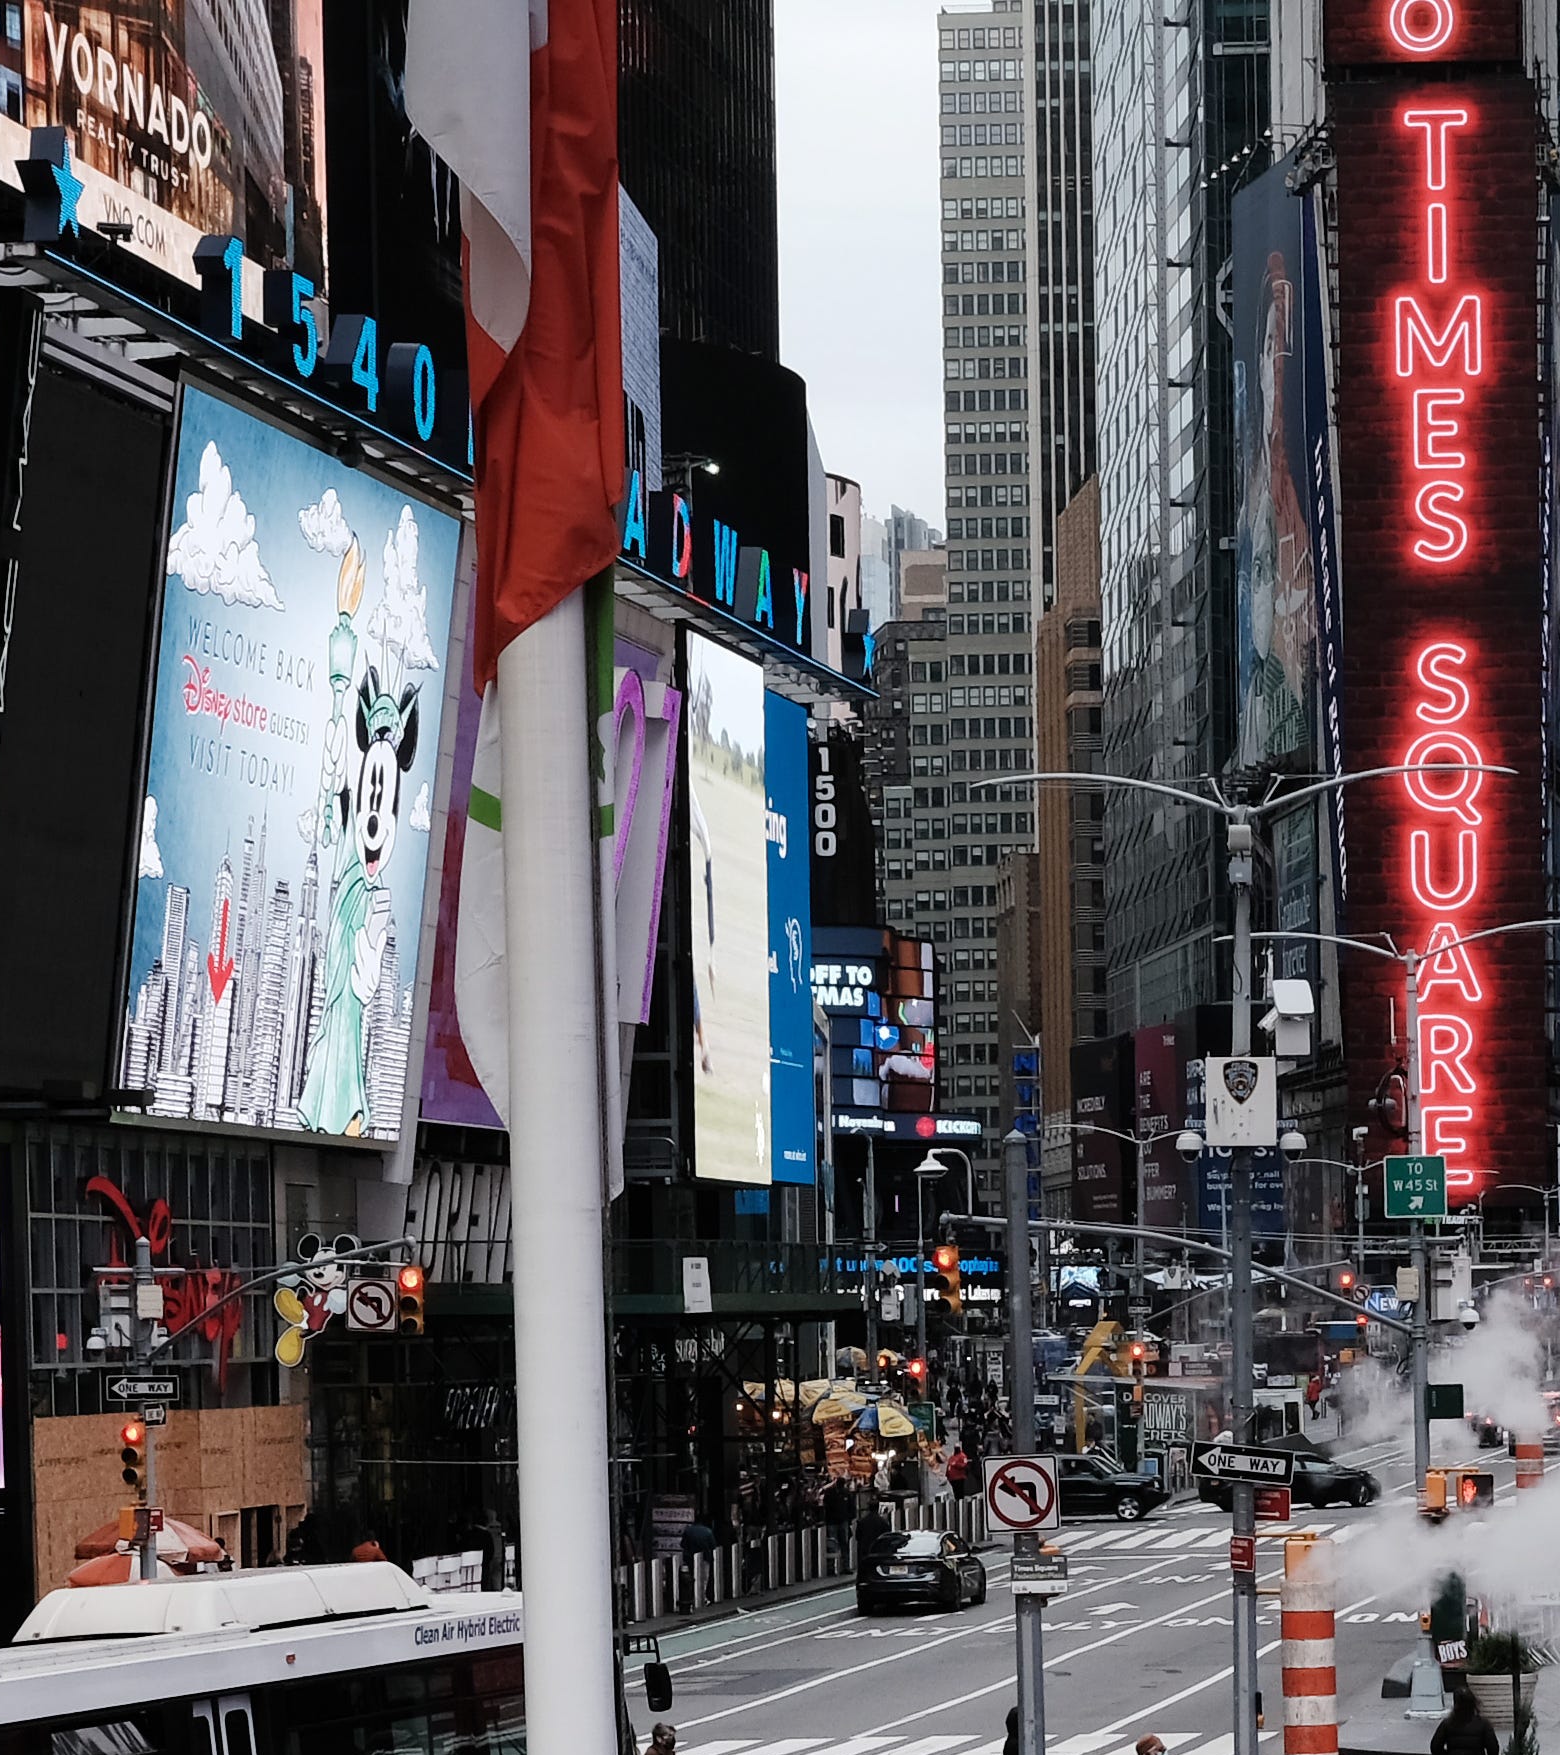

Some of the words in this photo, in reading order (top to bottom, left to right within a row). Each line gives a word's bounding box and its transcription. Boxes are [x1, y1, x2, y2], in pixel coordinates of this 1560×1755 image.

[46, 10, 213, 172] VORNADO
[75, 106, 137, 168] REALTY
[139, 147, 190, 195] TRUST
[1395, 109, 1482, 563] TIMES
[190, 615, 267, 675] WELCOME
[276, 650, 315, 692] BACK
[233, 693, 267, 731] store
[270, 713, 310, 745] GUESTS!
[190, 734, 231, 777] VISIT
[240, 750, 295, 796] TODAY!
[815, 747, 837, 858] 1500
[1407, 1162, 1423, 1176] TO
[1208, 1454, 1235, 1469] ONE
[1249, 1457, 1281, 1473] WAY
[414, 1623, 440, 1646] Clean
[441, 1621, 455, 1641] Air
[456, 1616, 486, 1642] Hybrid
[487, 1612, 521, 1637] Electric
